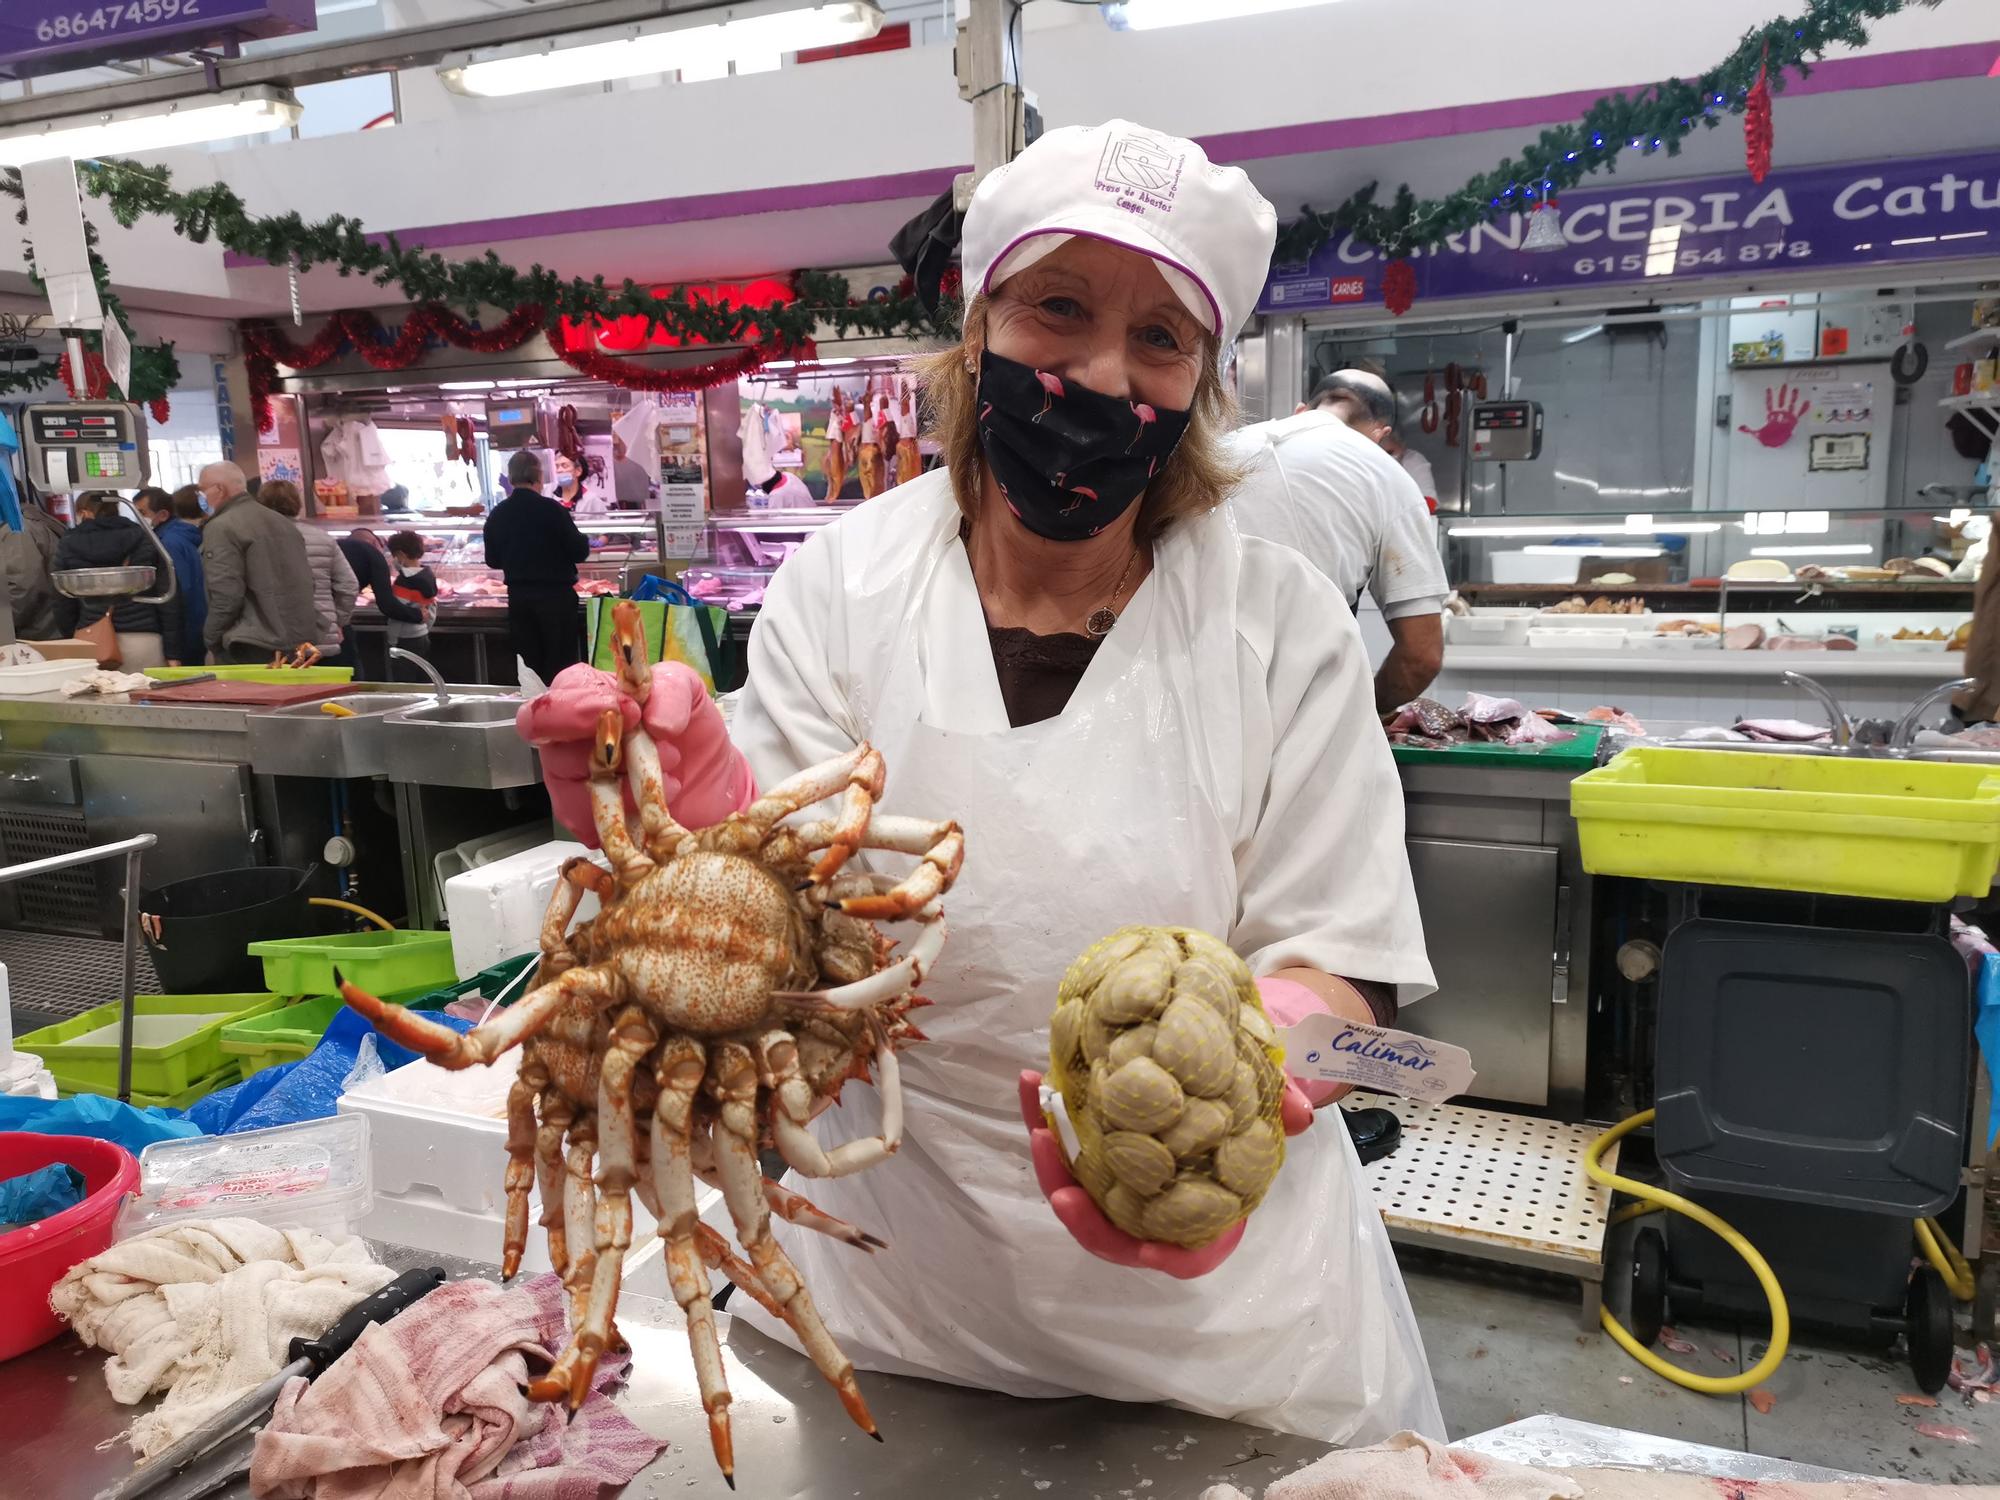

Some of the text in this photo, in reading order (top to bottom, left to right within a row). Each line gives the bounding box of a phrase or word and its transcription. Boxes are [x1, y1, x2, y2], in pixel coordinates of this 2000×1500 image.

[37, 0, 199, 41] 686474592
[1116, 197, 1146, 214] Cangas
[1125, 187, 1135, 197] de
[1139, 192, 1172, 213] Abastos
[1573, 254, 1641, 275] 615
[1332, 281, 1364, 296] CARNES
[1332, 1031, 1436, 1071] Calimar
